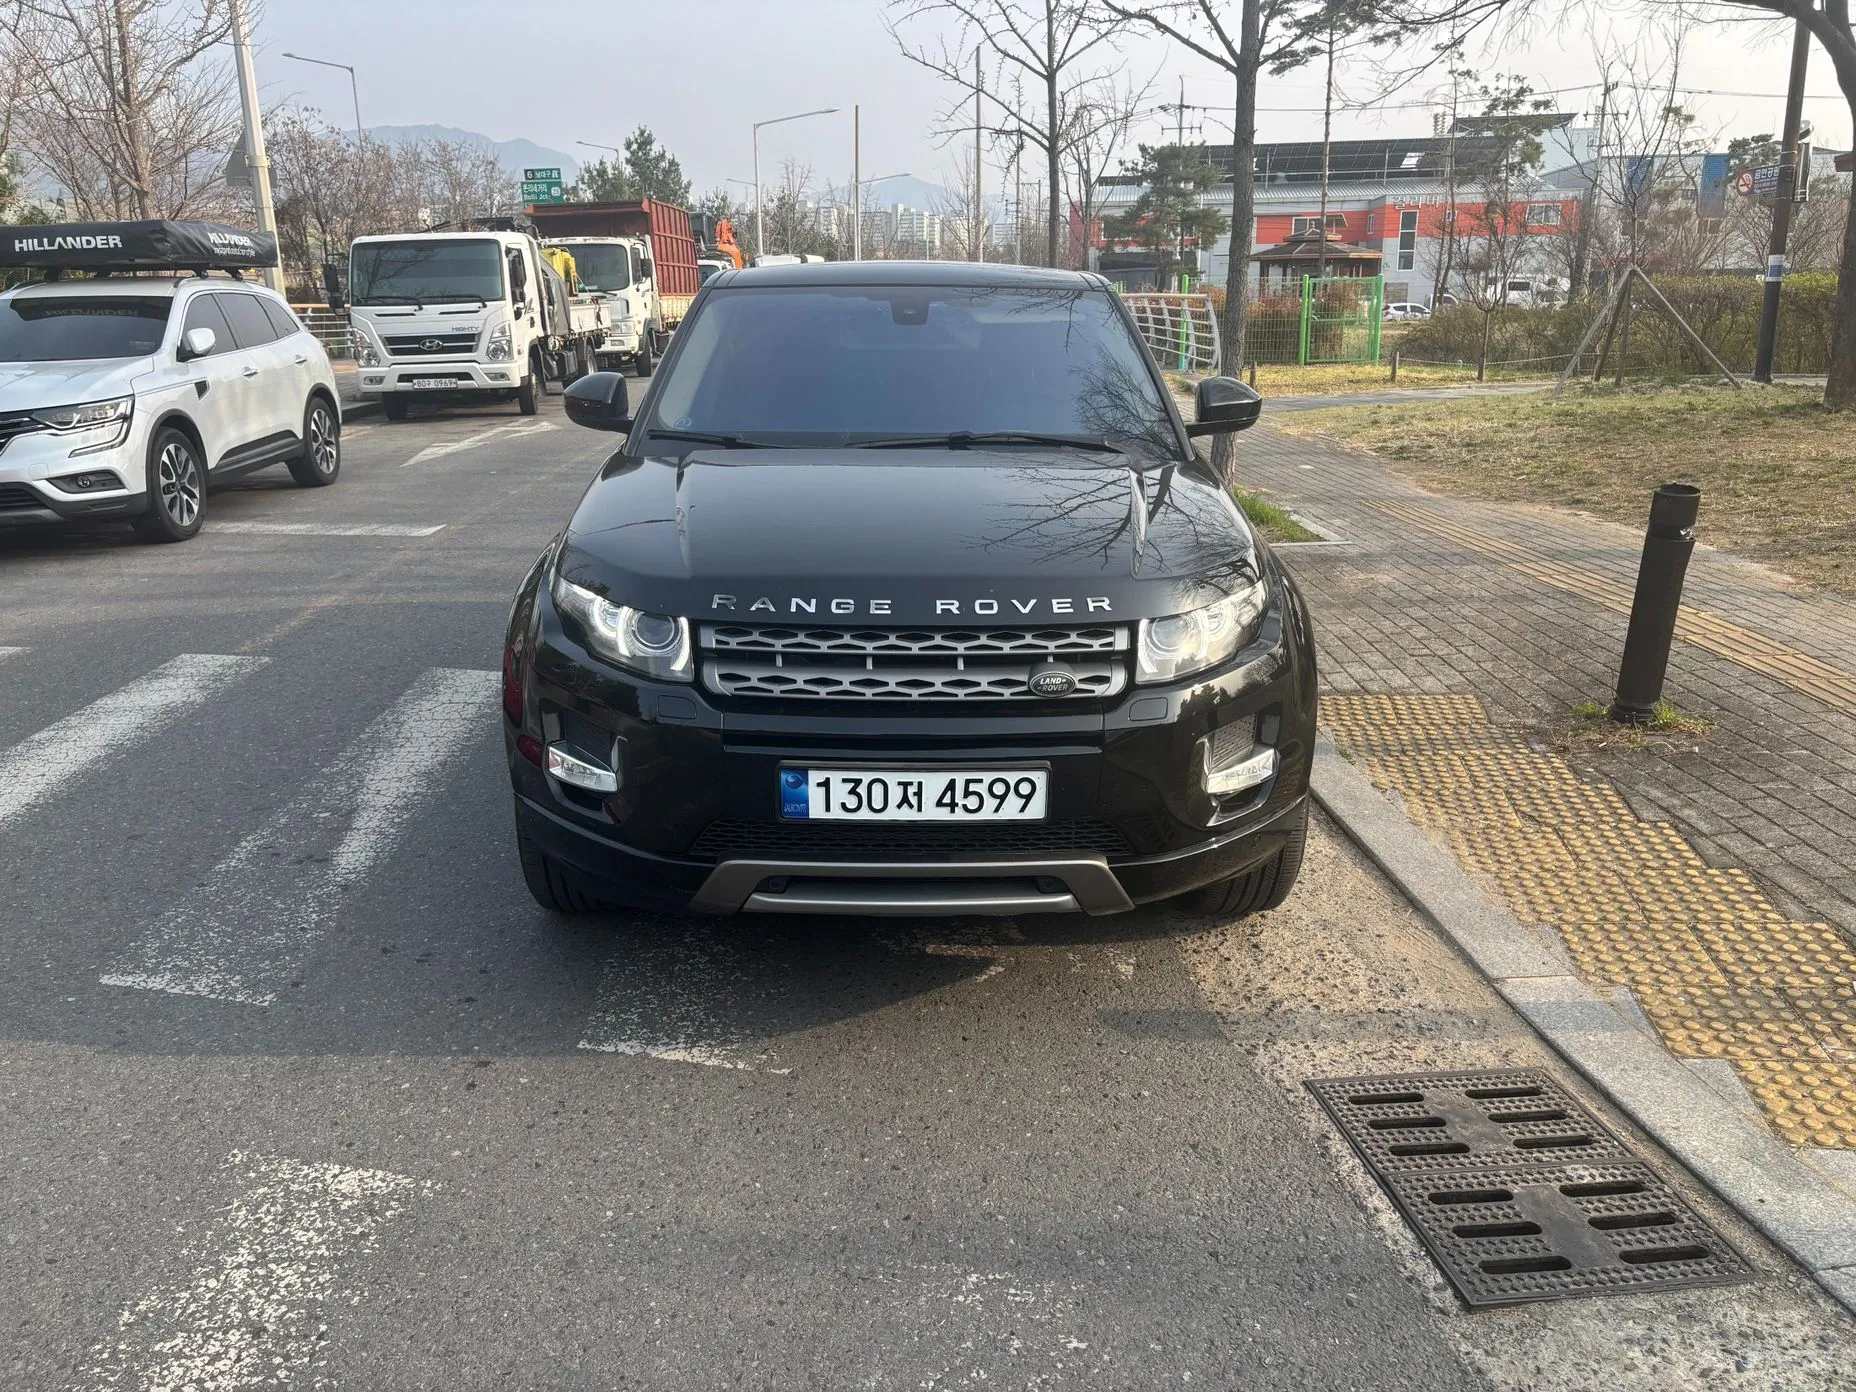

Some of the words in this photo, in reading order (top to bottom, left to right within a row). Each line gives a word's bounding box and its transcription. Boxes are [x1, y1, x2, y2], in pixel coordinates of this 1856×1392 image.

[527, 171, 533, 179] 6
[14, 235, 123, 252] HILLANDER
[711, 594, 892, 615] RANGE
[935, 596, 1113, 615] ROVER
[1040, 677, 1062, 685] LAND
[1041, 684, 1069, 692] ROVER
[816, 776, 923, 814] 130저
[935, 776, 1038, 814] 4599
